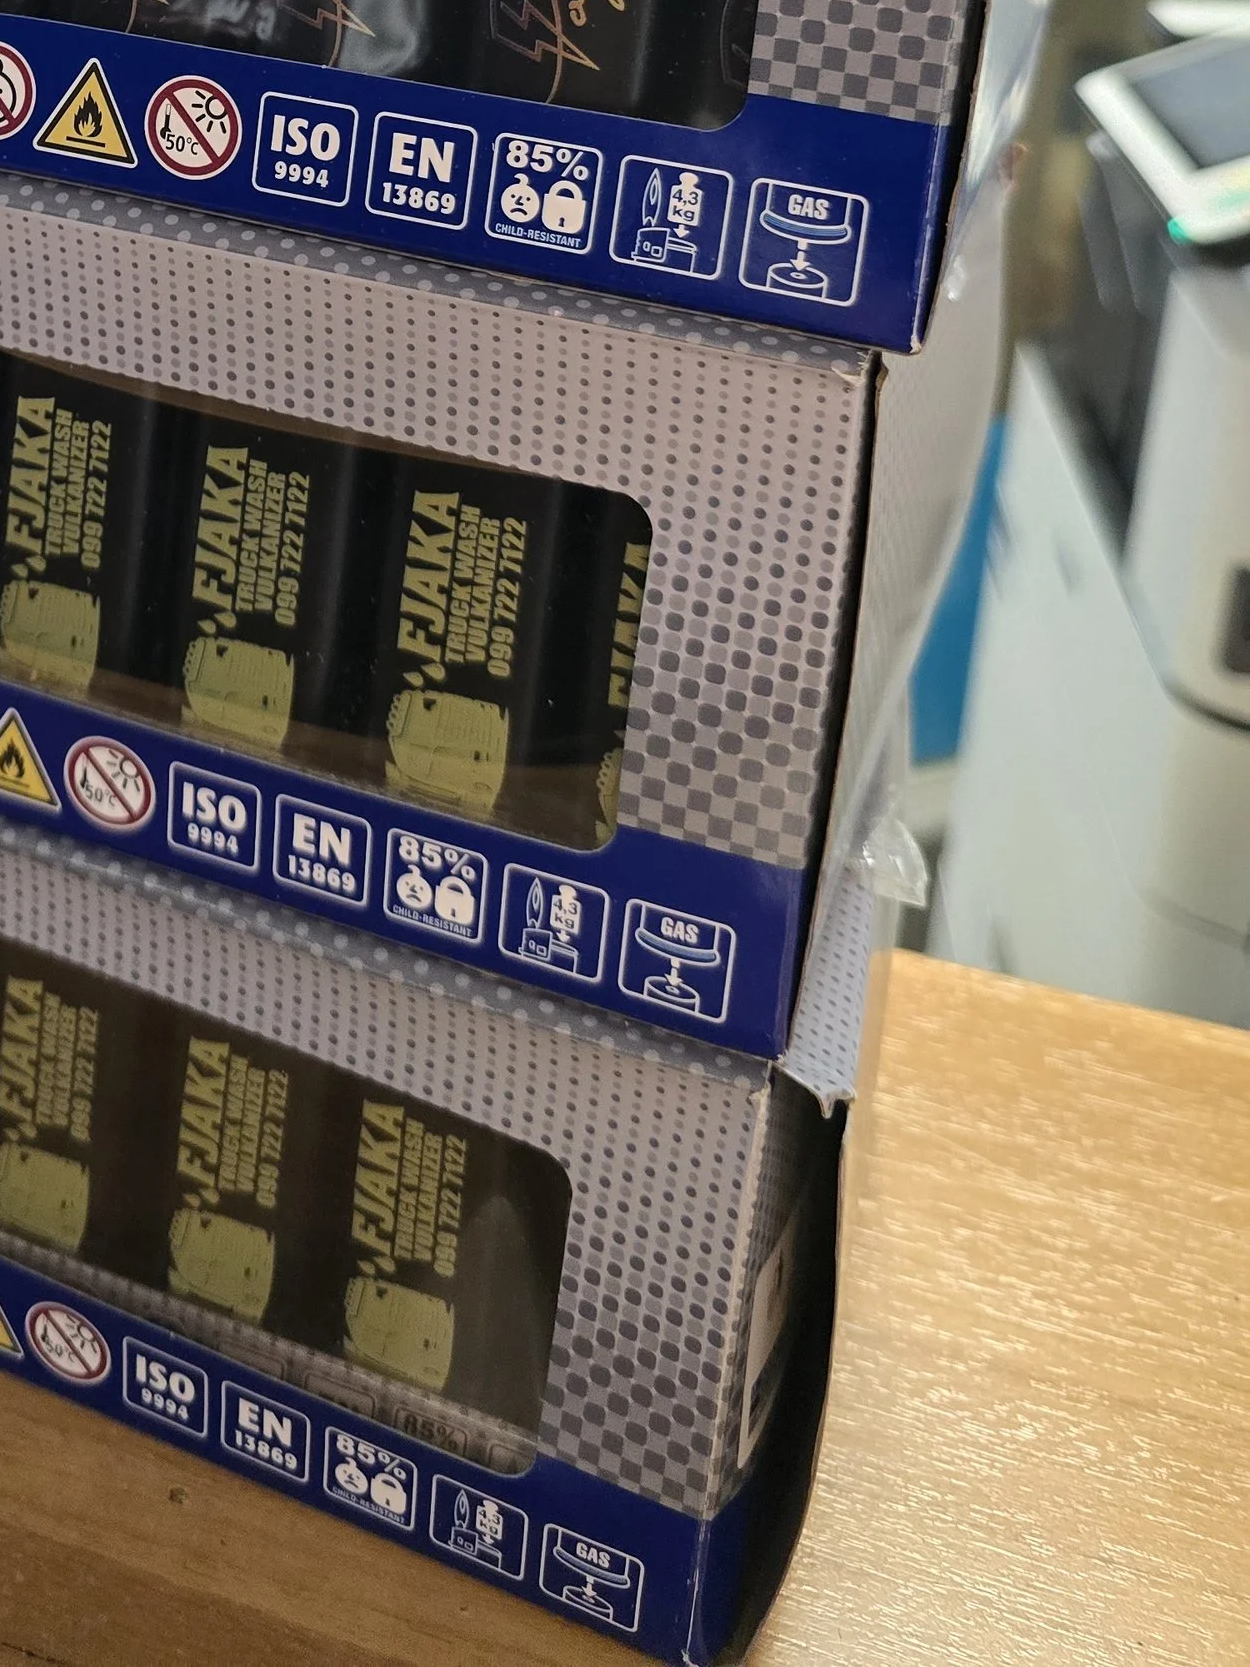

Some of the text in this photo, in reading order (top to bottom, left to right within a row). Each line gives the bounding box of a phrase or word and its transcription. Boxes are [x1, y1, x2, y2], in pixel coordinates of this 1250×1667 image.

[270, 115, 341, 162] ISO
[388, 132, 455, 183] EN
[506, 140, 589, 181] 85%
[274, 161, 330, 188] 9994
[382, 182, 456, 215] 13869
[671, 188, 699, 207] 4,3
[672, 204, 696, 223] kg
[788, 194, 829, 220] GAS
[495, 222, 582, 248] CHILD-RESISTANT
[6, 396, 55, 557] FJAKA
[45, 408, 73, 557] TRUCK WASH
[60, 420, 90, 555] VULKANIZER
[81, 420, 112, 569] 099 722 7122
[192, 445, 248, 611] FJAKA
[235, 459, 268, 612] TRUCK WASH
[254, 471, 286, 613] VULKANIZER
[275, 471, 310, 627] 099 722 7122
[397, 490, 459, 671] FJAKA
[445, 504, 481, 663] TRUCK WASH
[465, 517, 500, 664] VULKANIZER
[488, 516, 527, 678] 099 722 7122
[182, 781, 247, 830] ISO
[187, 822, 239, 855] 9994
[292, 813, 351, 865] EN
[398, 835, 477, 880] 85%
[287, 855, 356, 894] 13869
[660, 916, 700, 944] GAS
[176, 1036, 230, 1188] FJAKA
[260, 1120, 284, 1161] 722
[442, 1133, 467, 1187] 7122
[352, 1098, 405, 1257] FJAKA
[394, 1117, 425, 1259] TRUCK WASH
[437, 1187, 461, 1230] 722
[135, 1354, 196, 1403] ISO
[141, 1387, 189, 1421] 9994
[238, 1398, 293, 1446] EN
[234, 1431, 298, 1470] 13869
[336, 1433, 407, 1480] 85%
[575, 1542, 611, 1569] GAS
